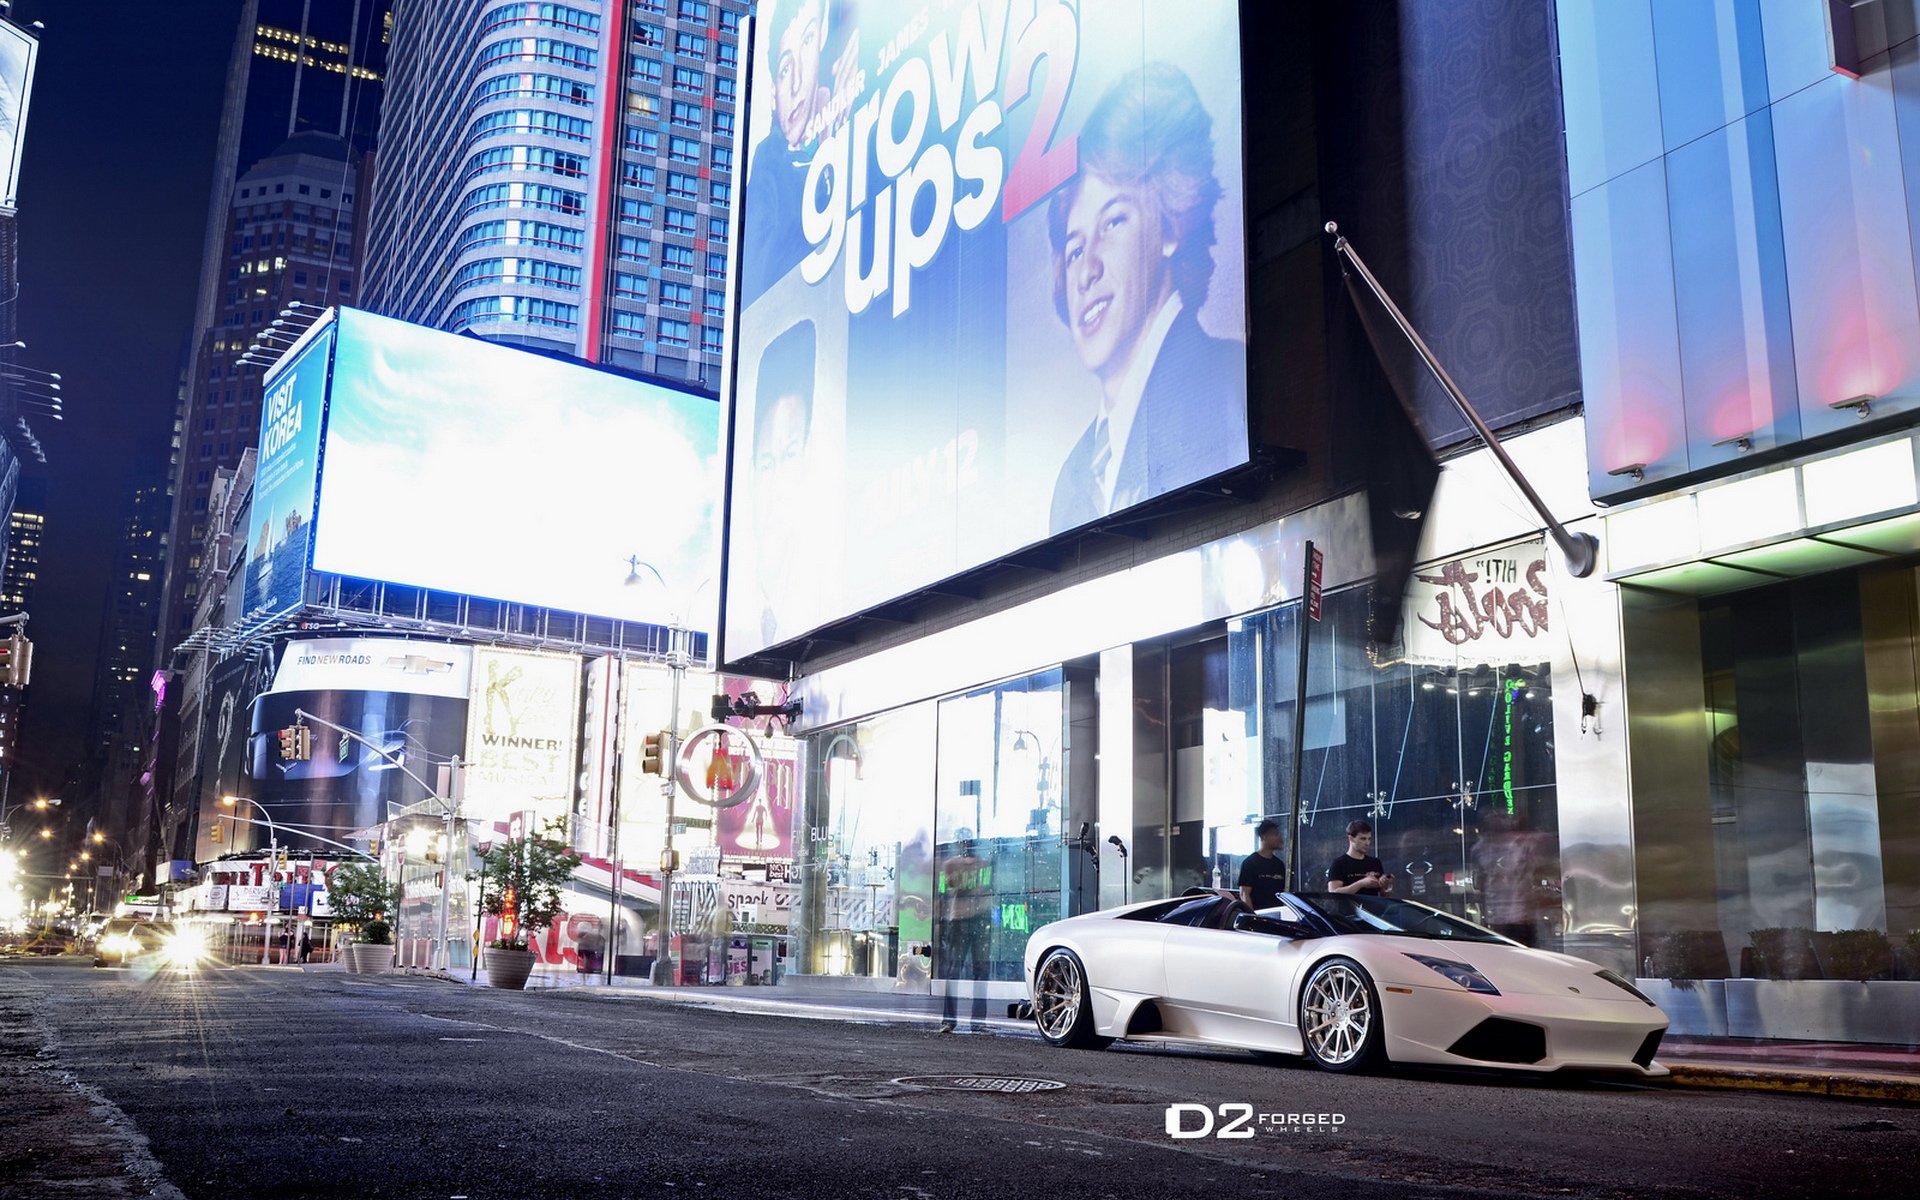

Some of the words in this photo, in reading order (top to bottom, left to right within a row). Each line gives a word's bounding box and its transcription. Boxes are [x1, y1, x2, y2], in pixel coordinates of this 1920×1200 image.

[801, 0, 1008, 284] grow
[845, 101, 1003, 318] ups
[1003, 2, 1077, 224] 2
[262, 400, 303, 463] KOREA
[267, 373, 297, 427] VISIT
[944, 429, 978, 496] 12
[297, 656, 317, 665] FIND
[317, 655, 338, 664] NEW
[339, 655, 372, 665] ROADS
[482, 734, 563, 752] WINNER!
